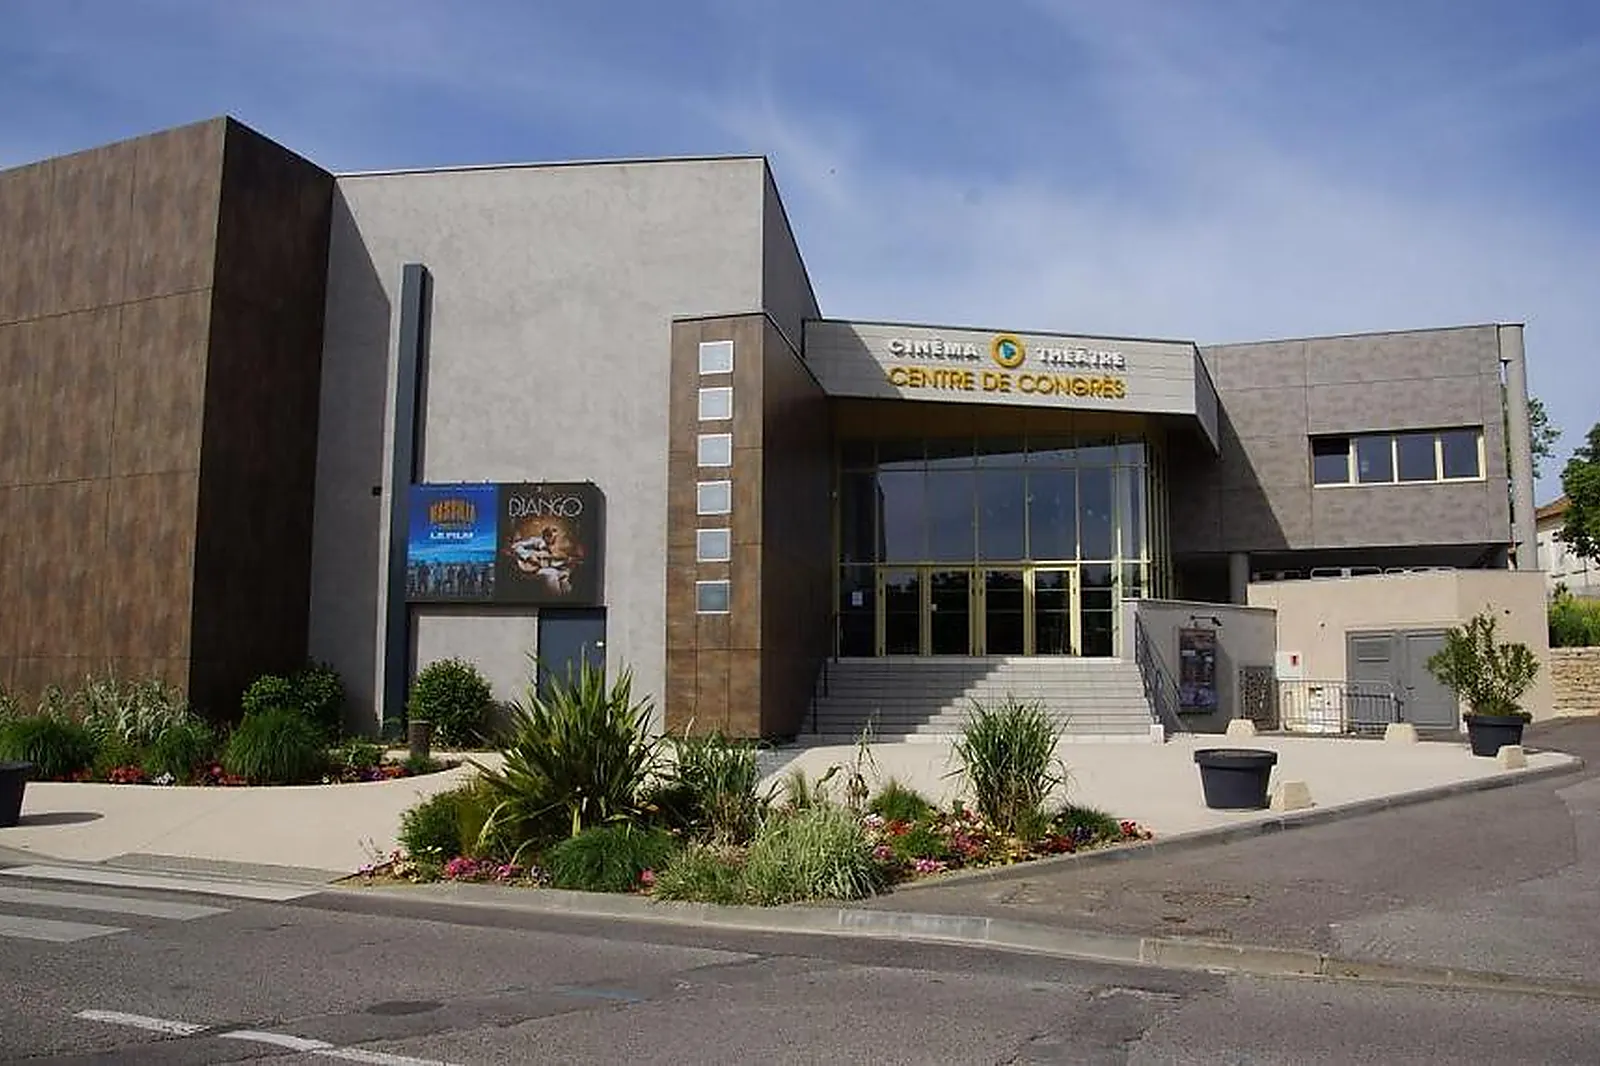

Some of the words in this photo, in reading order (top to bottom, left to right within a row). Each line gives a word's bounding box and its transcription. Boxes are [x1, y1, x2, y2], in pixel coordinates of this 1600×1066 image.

[888, 366, 975, 391] CENTRE
[981, 371, 1012, 393] DE
[1017, 374, 1126, 399] CONGRÈS
[508, 494, 584, 518] DJANGO
